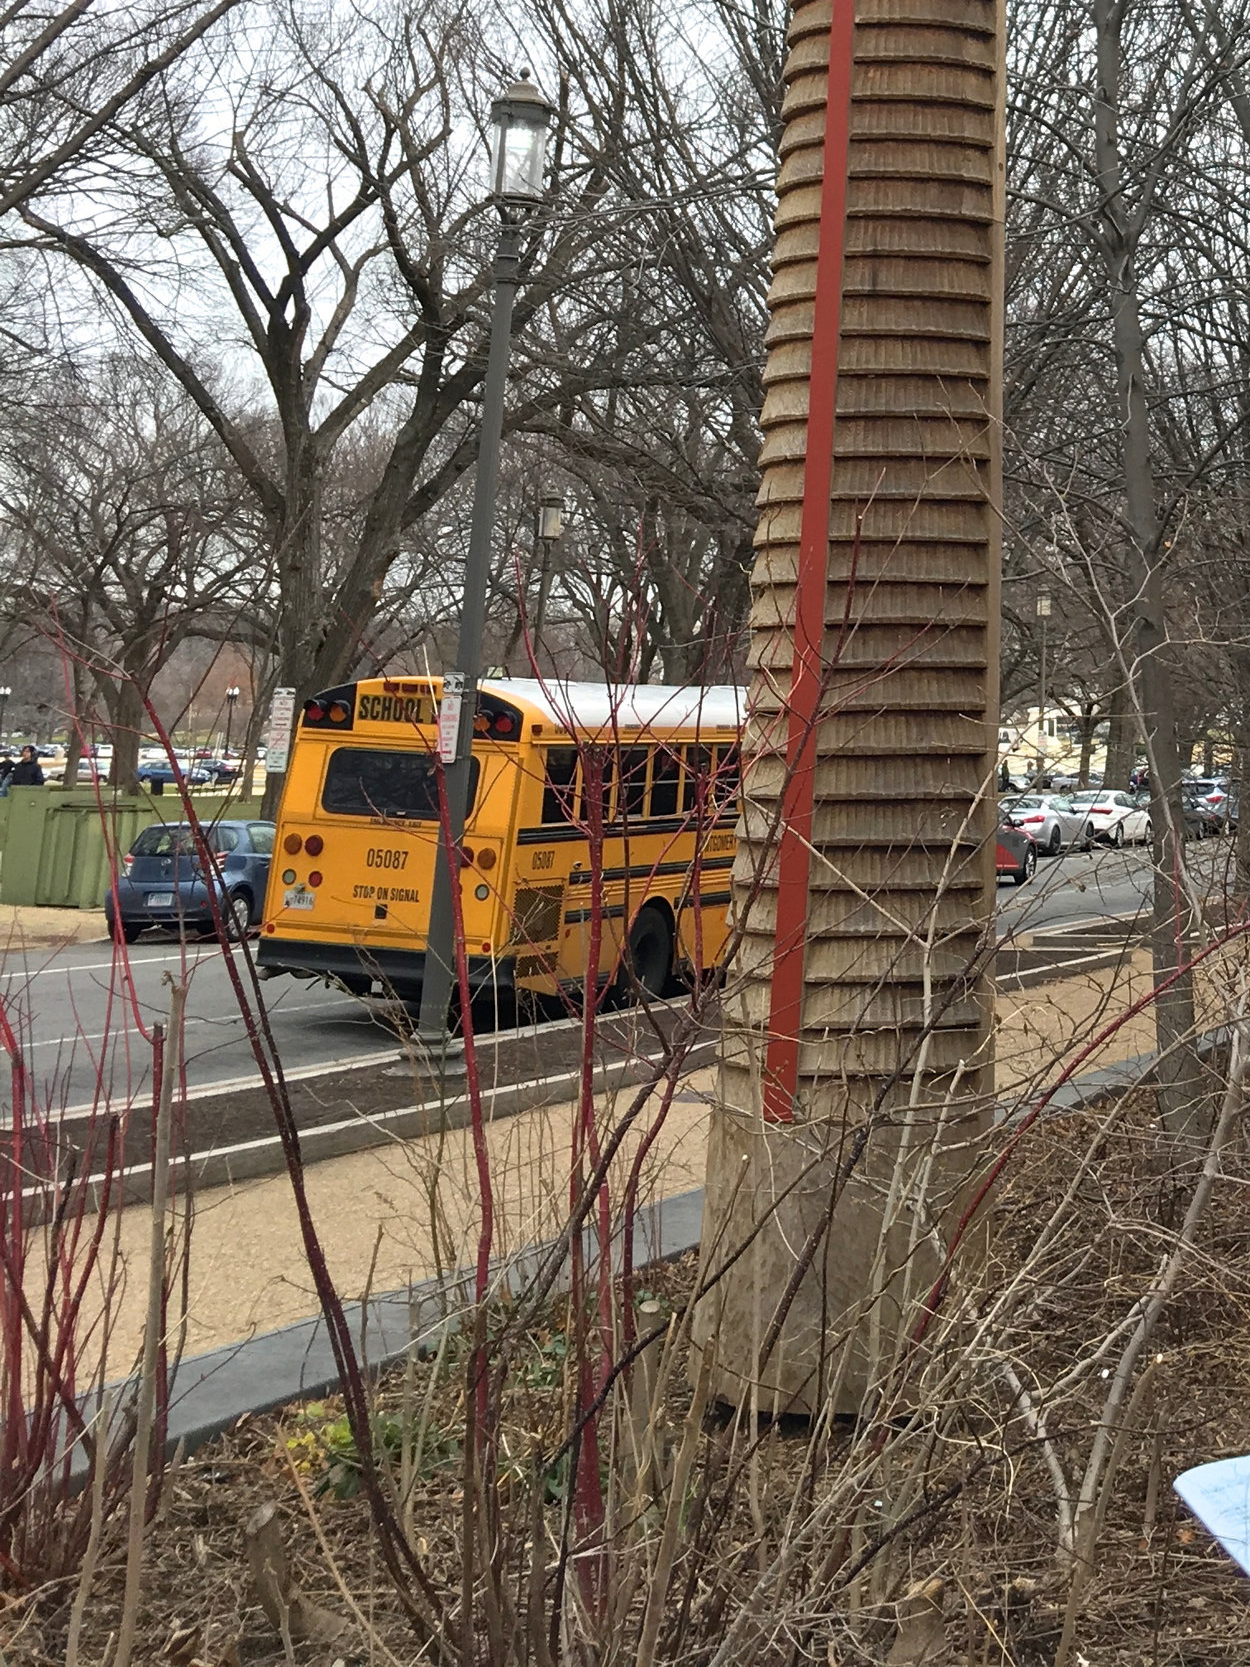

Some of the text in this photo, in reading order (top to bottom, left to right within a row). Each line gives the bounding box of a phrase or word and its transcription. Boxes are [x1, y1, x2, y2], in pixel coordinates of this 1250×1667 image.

[358, 695, 424, 723] SCHOOL
[366, 848, 409, 870] 05087
[532, 850, 556, 871] 05087
[352, 884, 420, 903] STOP ON SIGNAL
